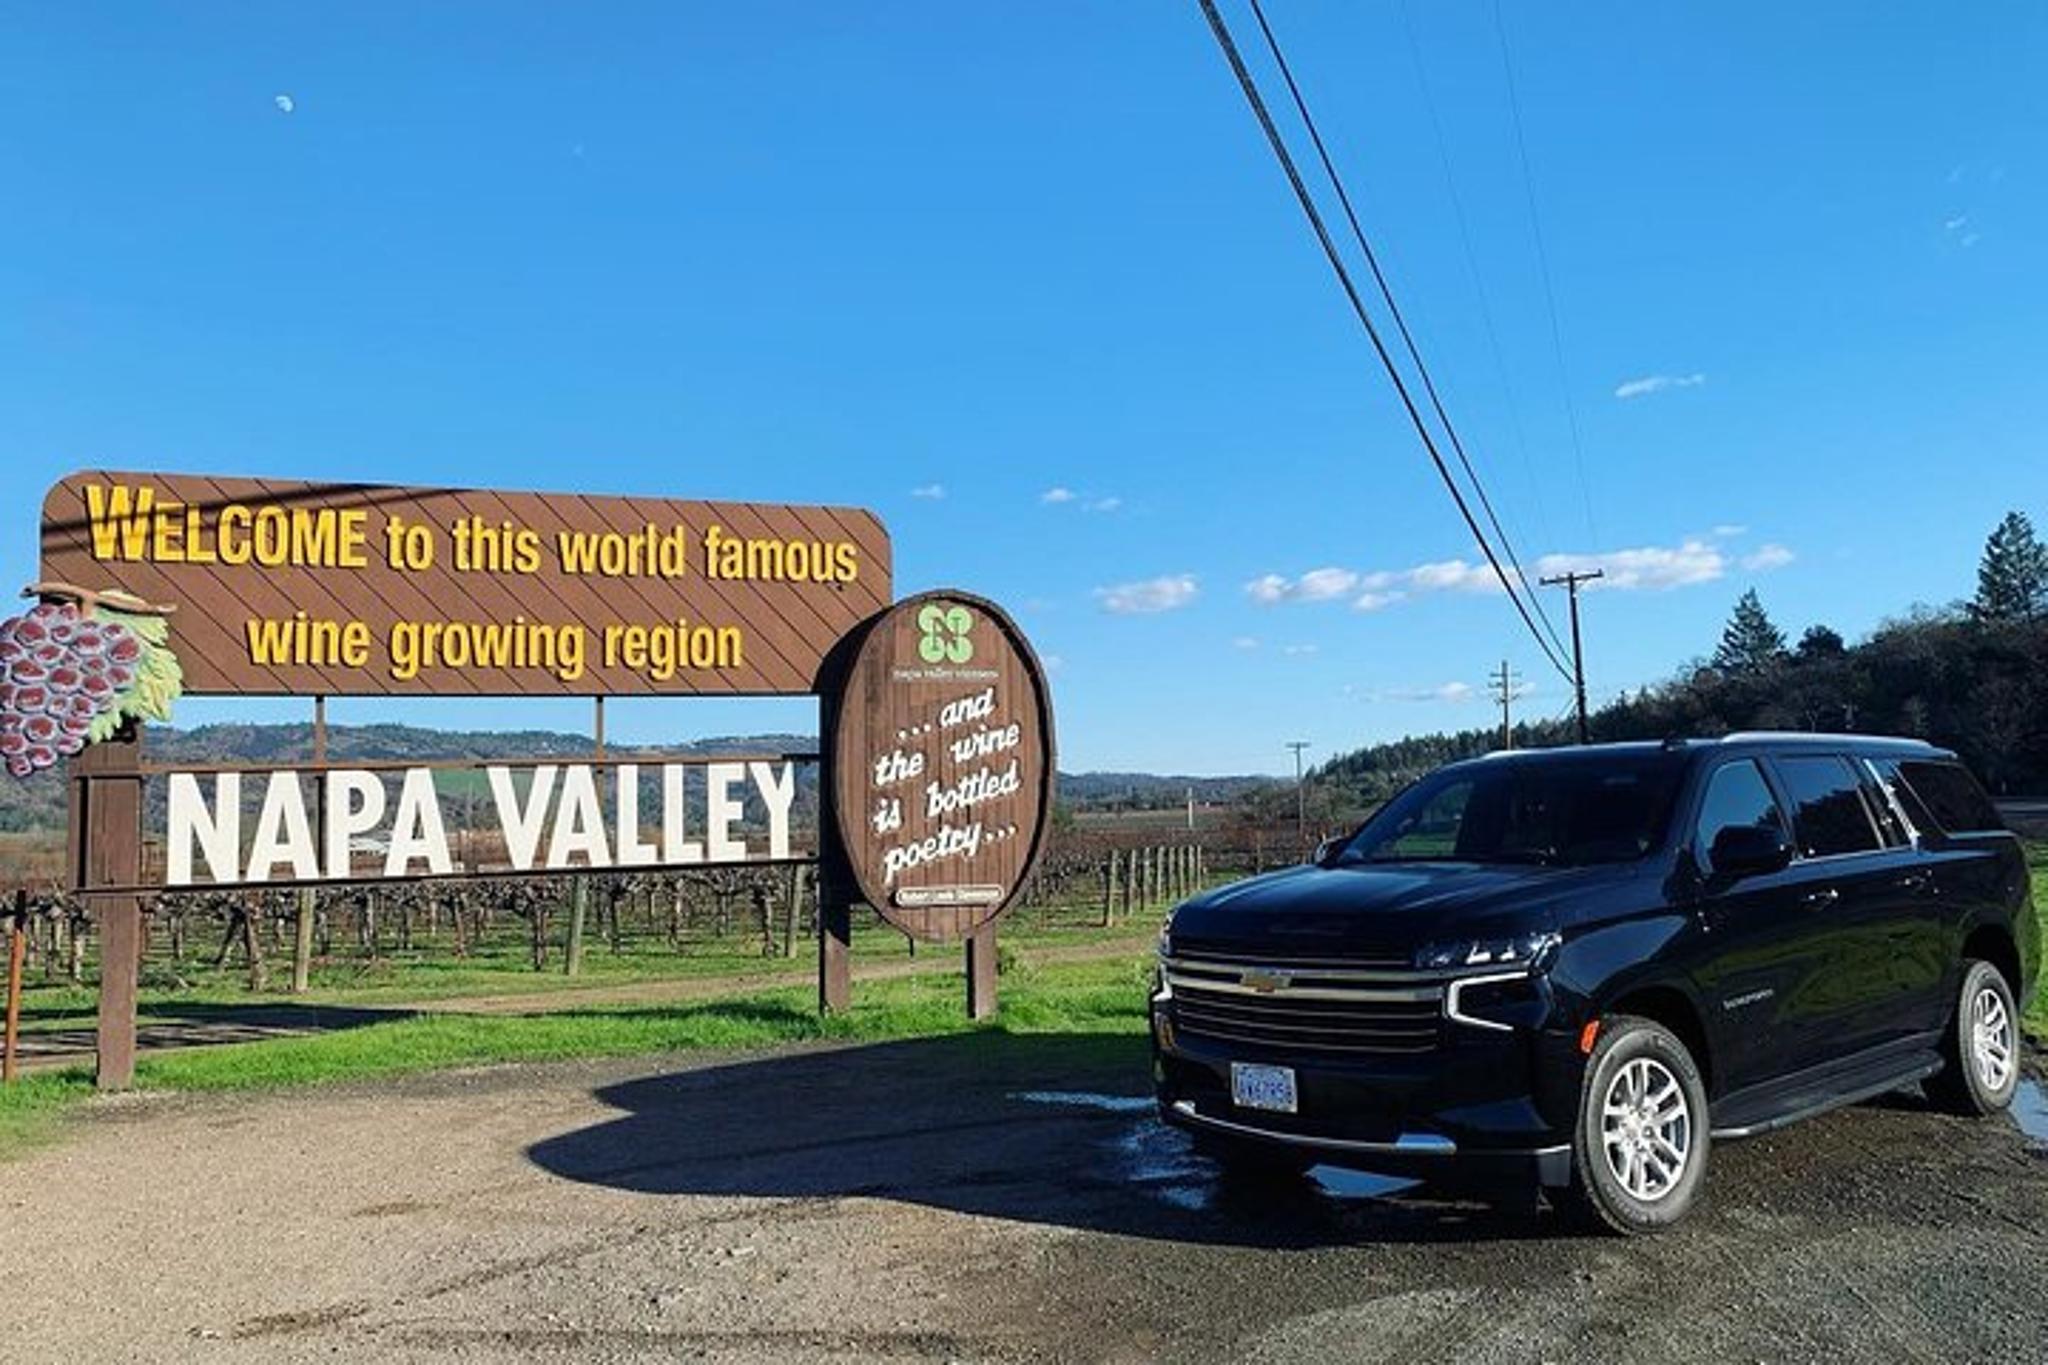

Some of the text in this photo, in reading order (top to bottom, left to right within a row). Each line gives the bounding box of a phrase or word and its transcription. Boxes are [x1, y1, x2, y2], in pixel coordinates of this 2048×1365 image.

[85, 484, 859, 581] WELCOME to this world famous
[248, 611, 743, 680] wine growing region
[875, 724, 1020, 785] the wine
[167, 762, 794, 885] NAPA VALLEY
[873, 759, 1020, 833] is bottled
